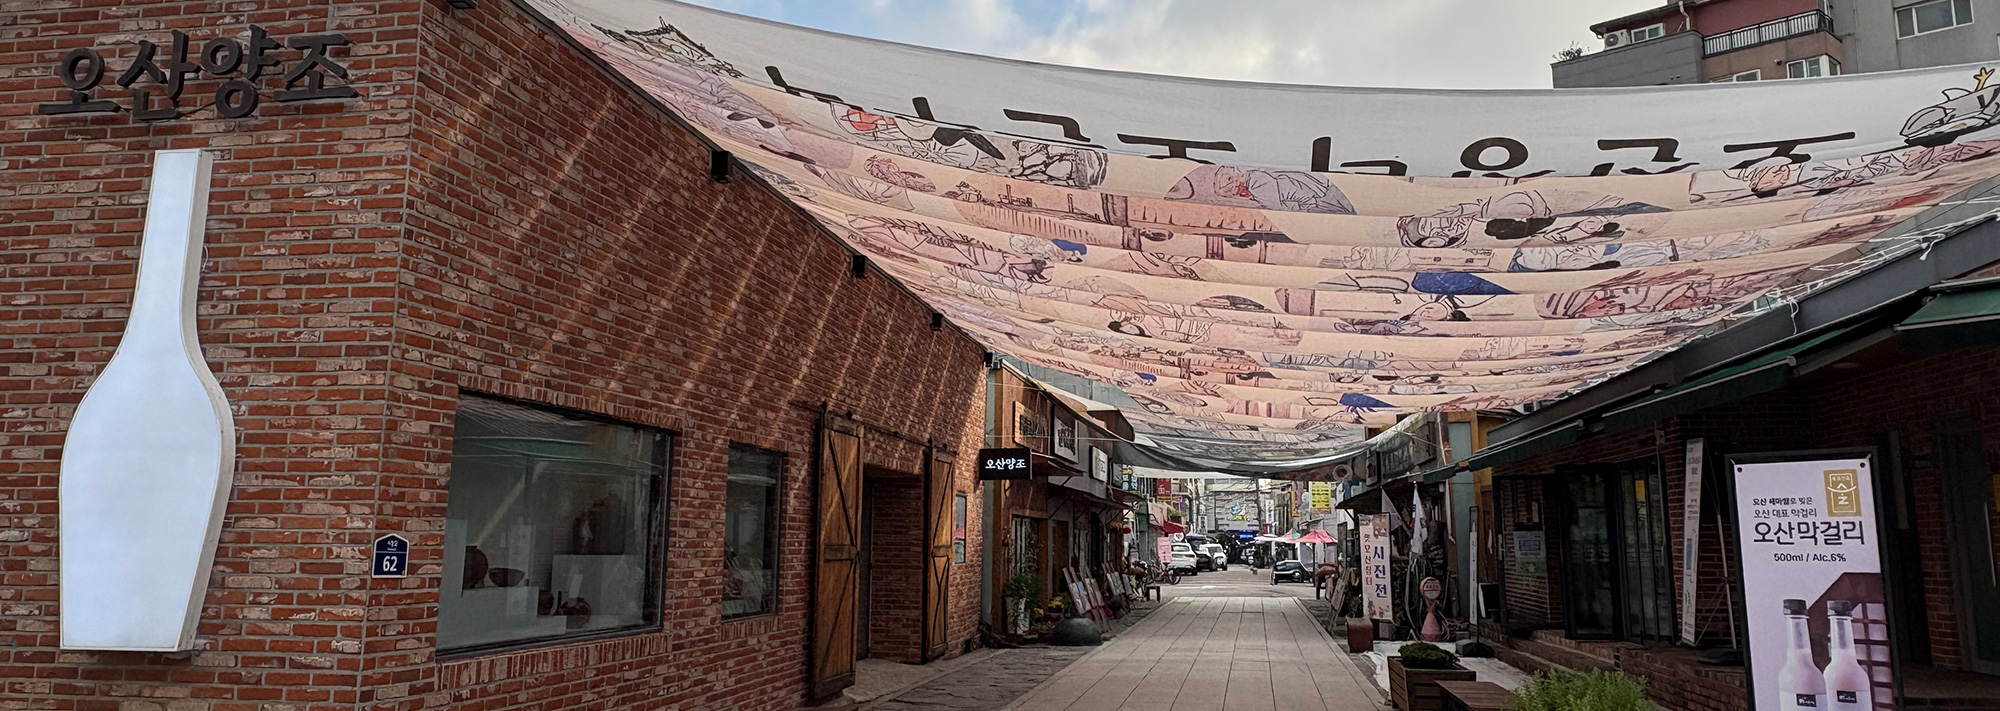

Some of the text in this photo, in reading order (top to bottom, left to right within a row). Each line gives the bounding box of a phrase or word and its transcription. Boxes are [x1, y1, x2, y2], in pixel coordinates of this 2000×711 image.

[38, 24, 358, 121] 오산양조
[984, 457, 1026, 470] 오산양조
[1753, 509, 1770, 519] 오산
[1772, 509, 1790, 518] 대표
[1753, 520, 1865, 546] 오산막걸리
[383, 555, 398, 572] 62
[1774, 553, 1804, 562] 500ml
[1812, 553, 1847, 562] Alc.6%
